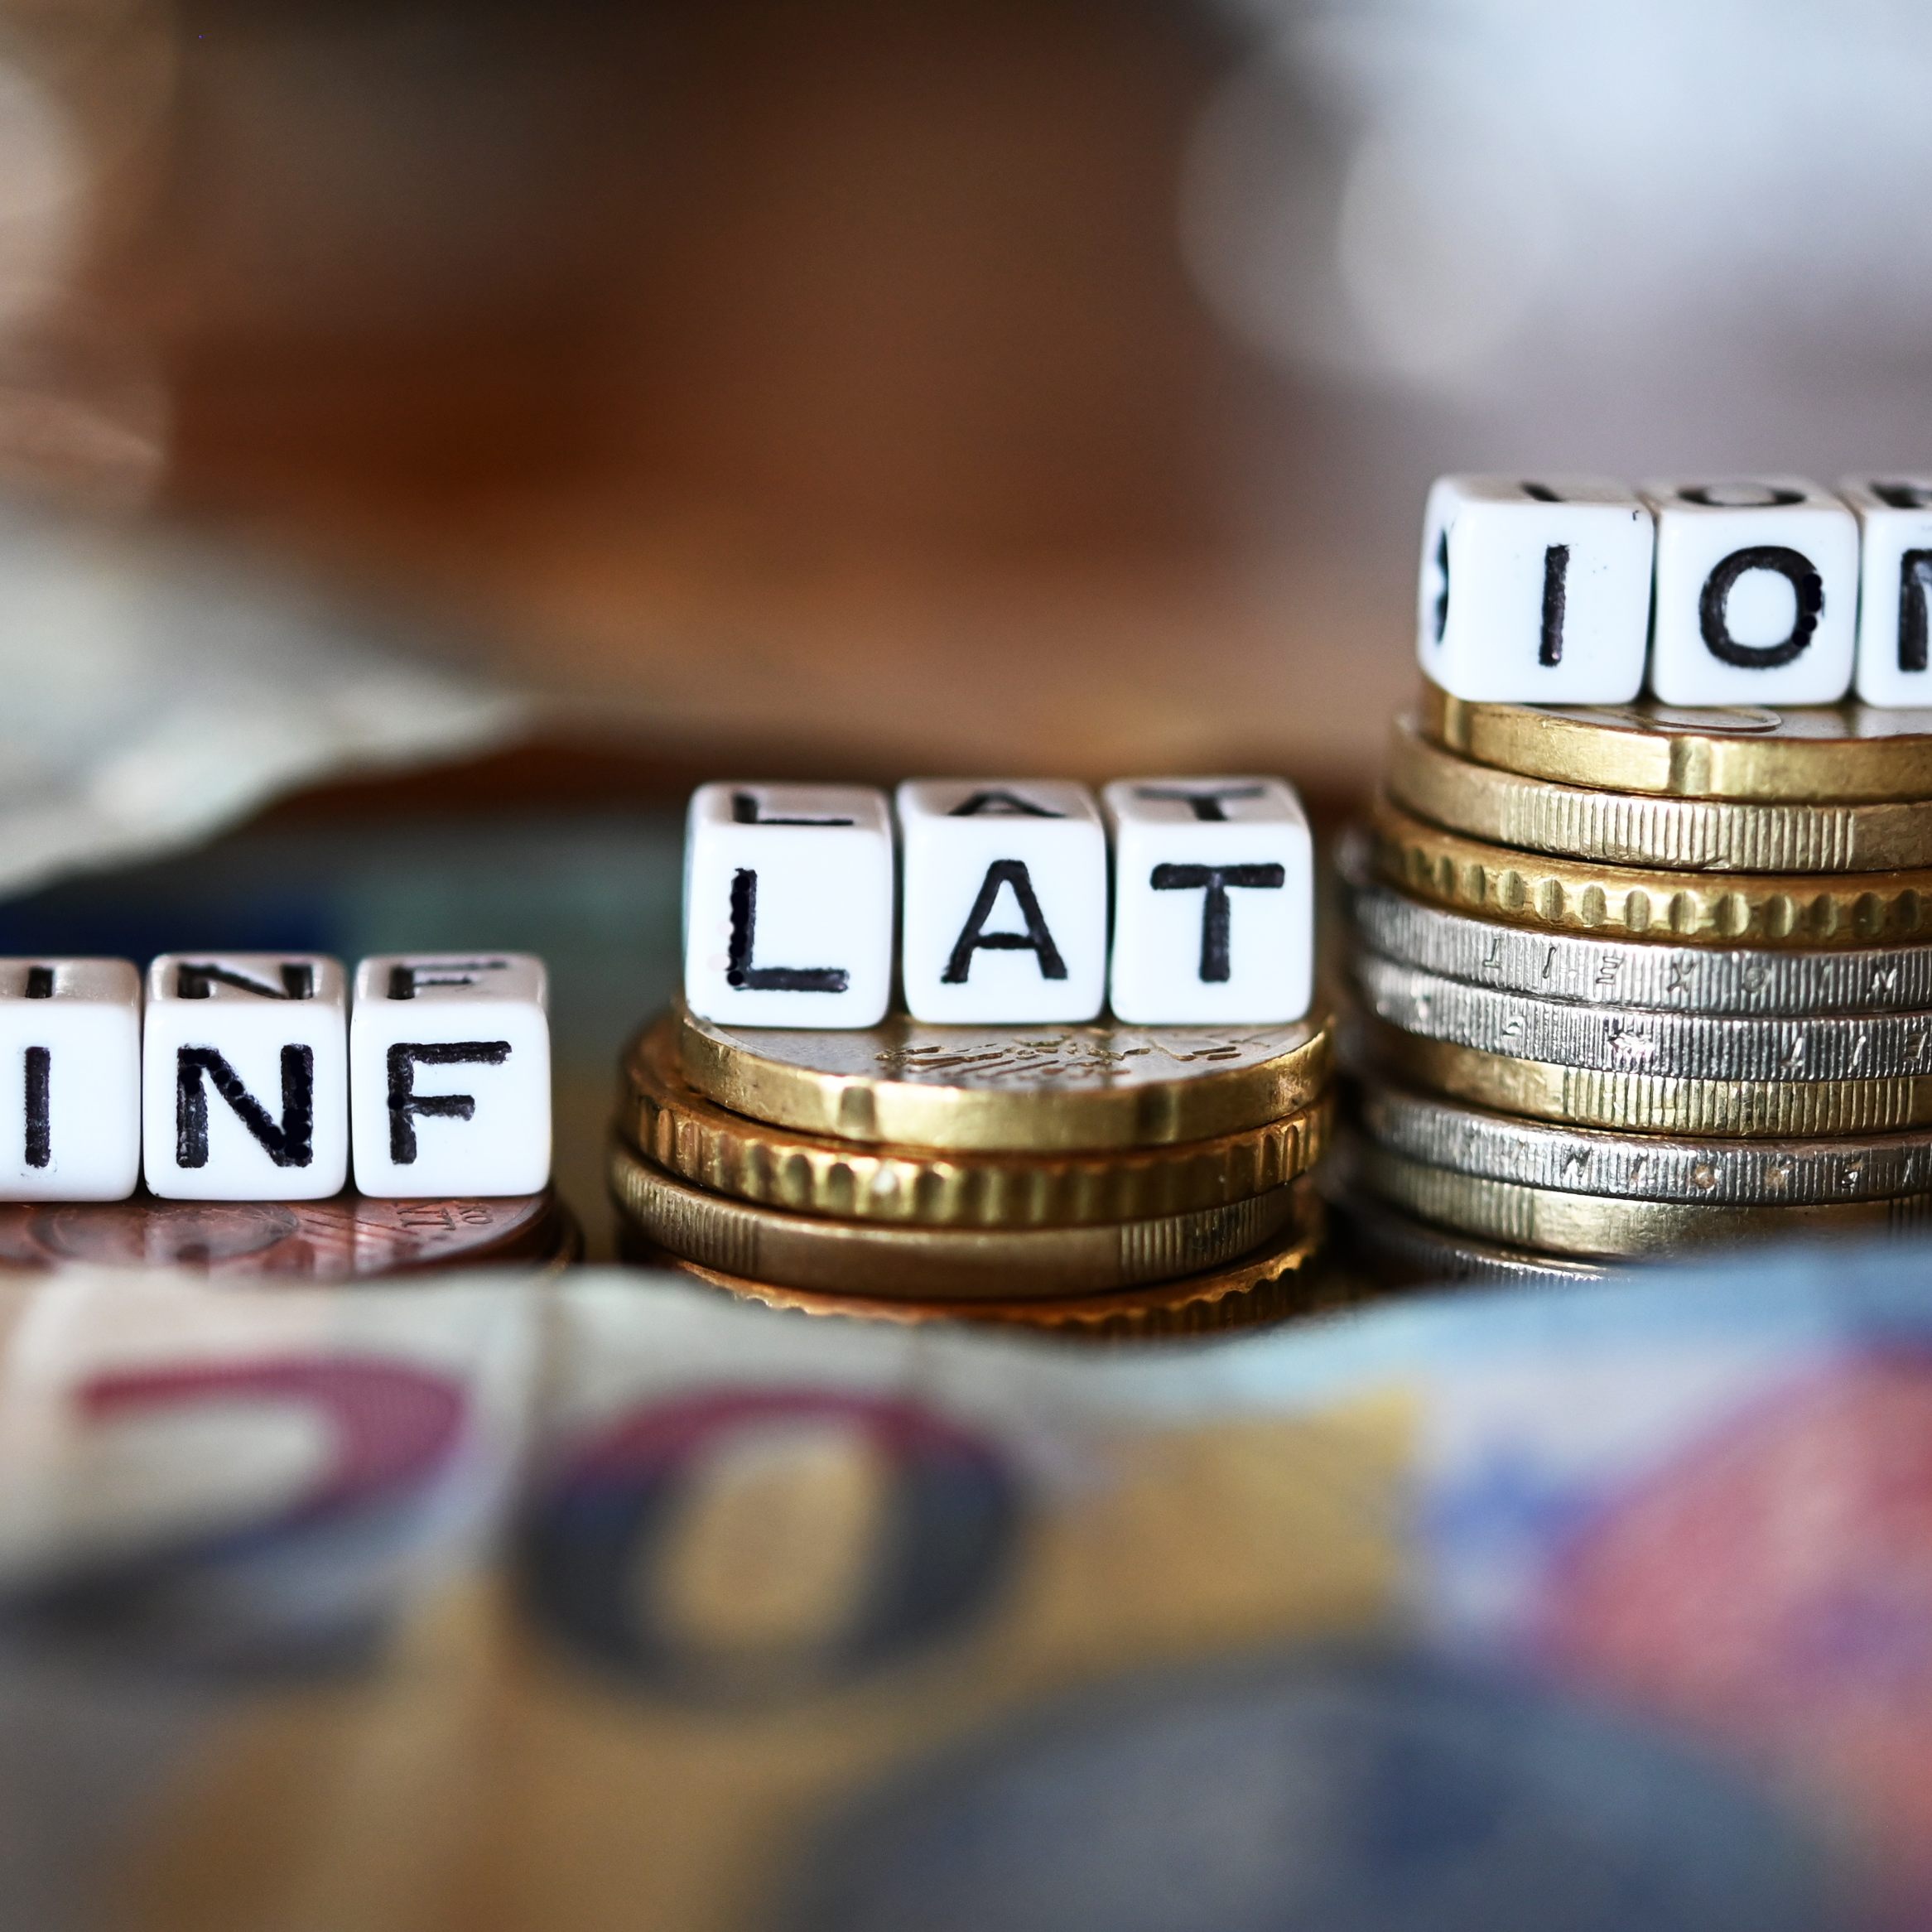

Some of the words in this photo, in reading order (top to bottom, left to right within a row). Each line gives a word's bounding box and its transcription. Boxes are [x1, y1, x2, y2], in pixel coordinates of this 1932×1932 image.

[1538, 543, 1932, 672] IO
[725, 859, 1285, 993] LAT
[23, 1040, 512, 1168] INF
